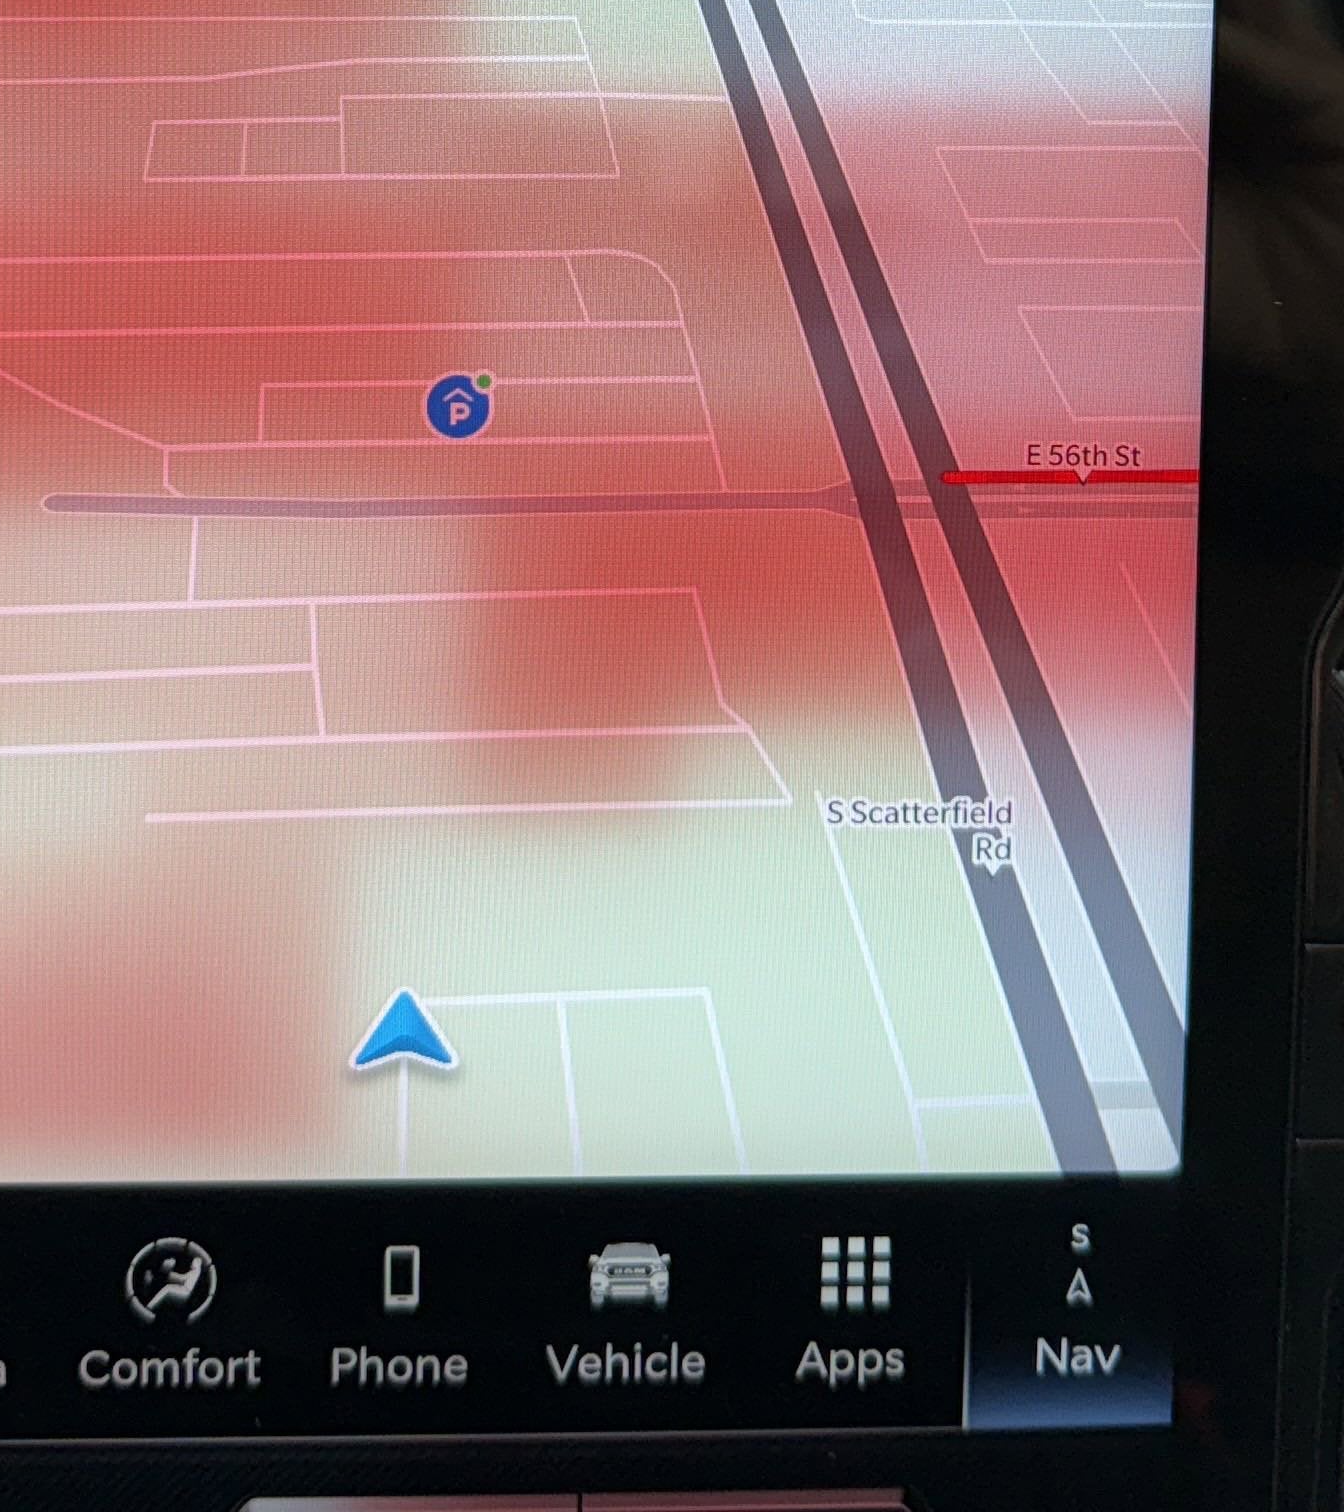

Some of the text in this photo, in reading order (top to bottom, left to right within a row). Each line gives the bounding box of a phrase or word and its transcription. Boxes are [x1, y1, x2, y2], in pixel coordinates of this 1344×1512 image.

[1028, 444, 1141, 467] E 56th St
[827, 800, 1012, 824] S Scatterfield
[976, 837, 1011, 860] Rd
[1071, 1223, 1090, 1254] S
[78, 1348, 262, 1389] Comfort
[330, 1346, 469, 1385] Phone
[546, 1341, 706, 1383] Vehicle
[796, 1340, 905, 1388] Apps
[1035, 1336, 1122, 1376] Nav
